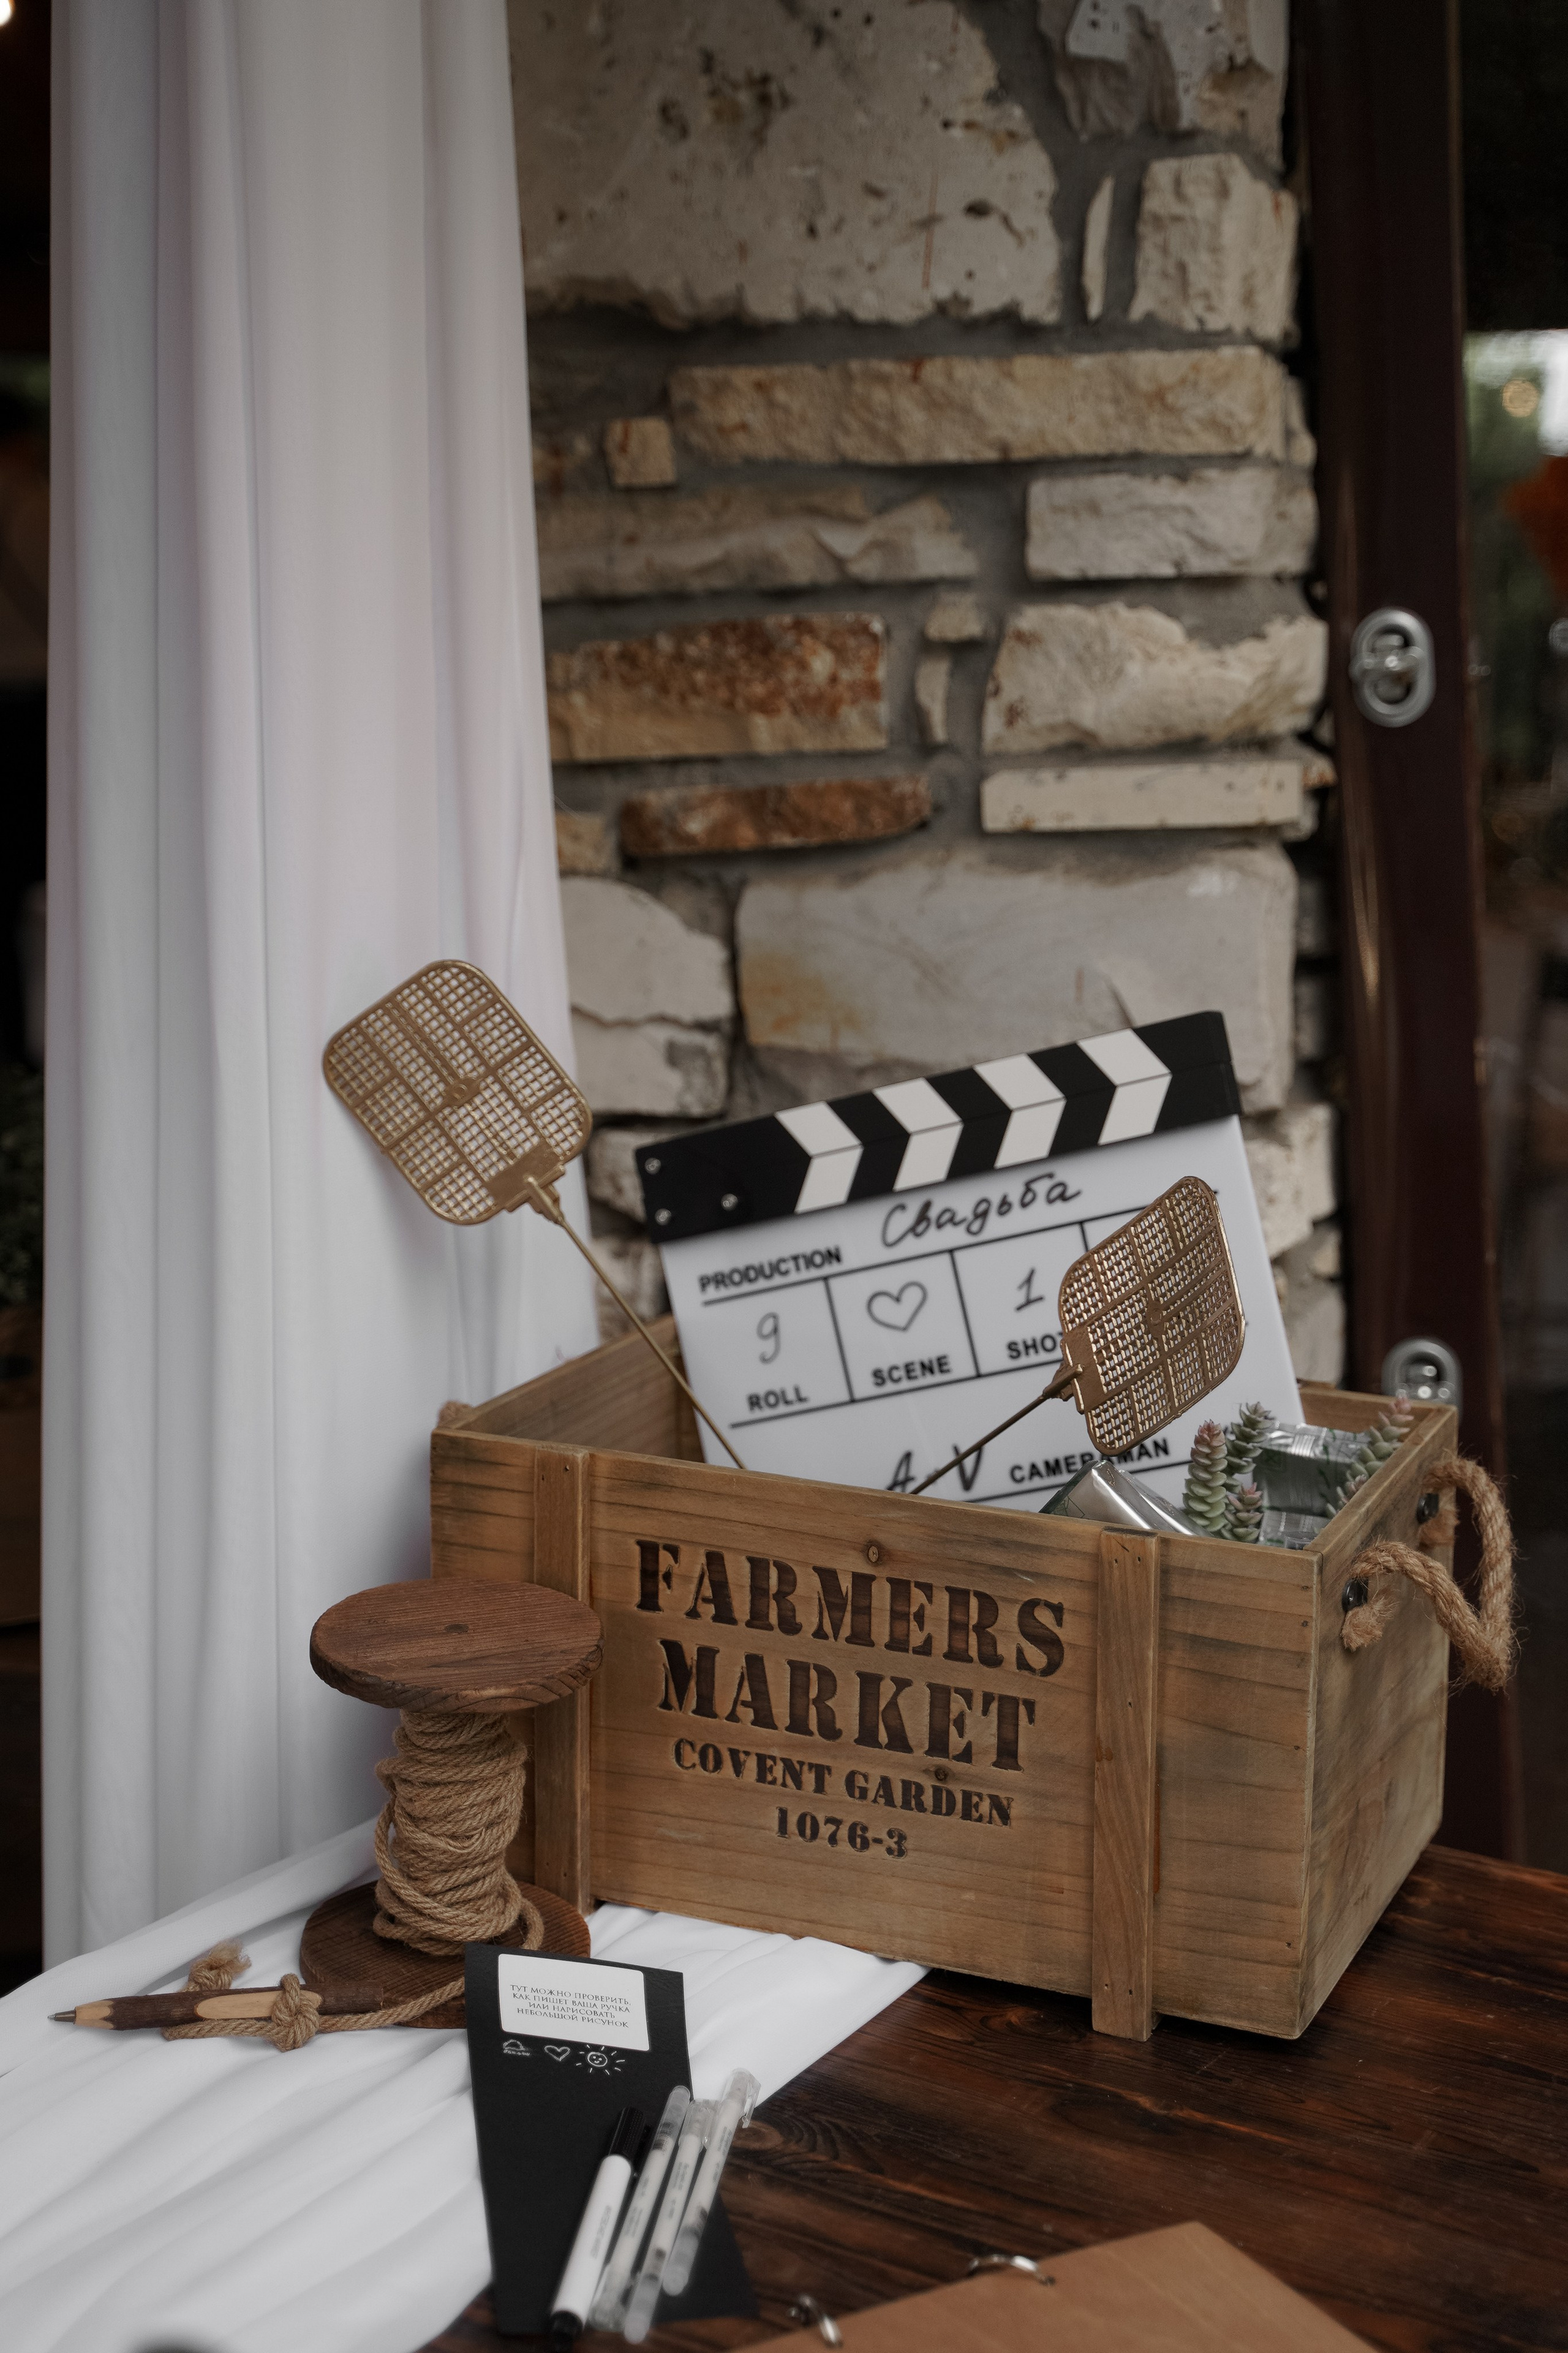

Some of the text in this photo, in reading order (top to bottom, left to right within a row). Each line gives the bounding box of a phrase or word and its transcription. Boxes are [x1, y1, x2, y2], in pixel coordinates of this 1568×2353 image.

[882, 1172, 1082, 1247] Свадьба
[699, 1245, 842, 1292] PRODUCTION
[1006, 1331, 1063, 1359] SHO
[872, 1354, 952, 1387] SCENE
[747, 1385, 809, 1413] ROLL
[635, 1539, 1065, 1677] FARMERS
[657, 1638, 1036, 1772] MARKET
[673, 1737, 1014, 1827] COVENT GARDEN
[775, 1806, 909, 1859] 1076-3
[530, 1987, 571, 1998] МОЖНО
[575, 1992, 631, 2006] ПРОВЕРИТЬ,
[533, 1995, 568, 2005] ПИШЕТ
[572, 2000, 598, 2009] ВАША
[601, 2003, 630, 2013] РУЧКА
[553, 2005, 615, 2019] НАРИСОВАТЬ
[517, 2007, 629, 2028] НЕБОЛЬШОЙ РИСУНОК
